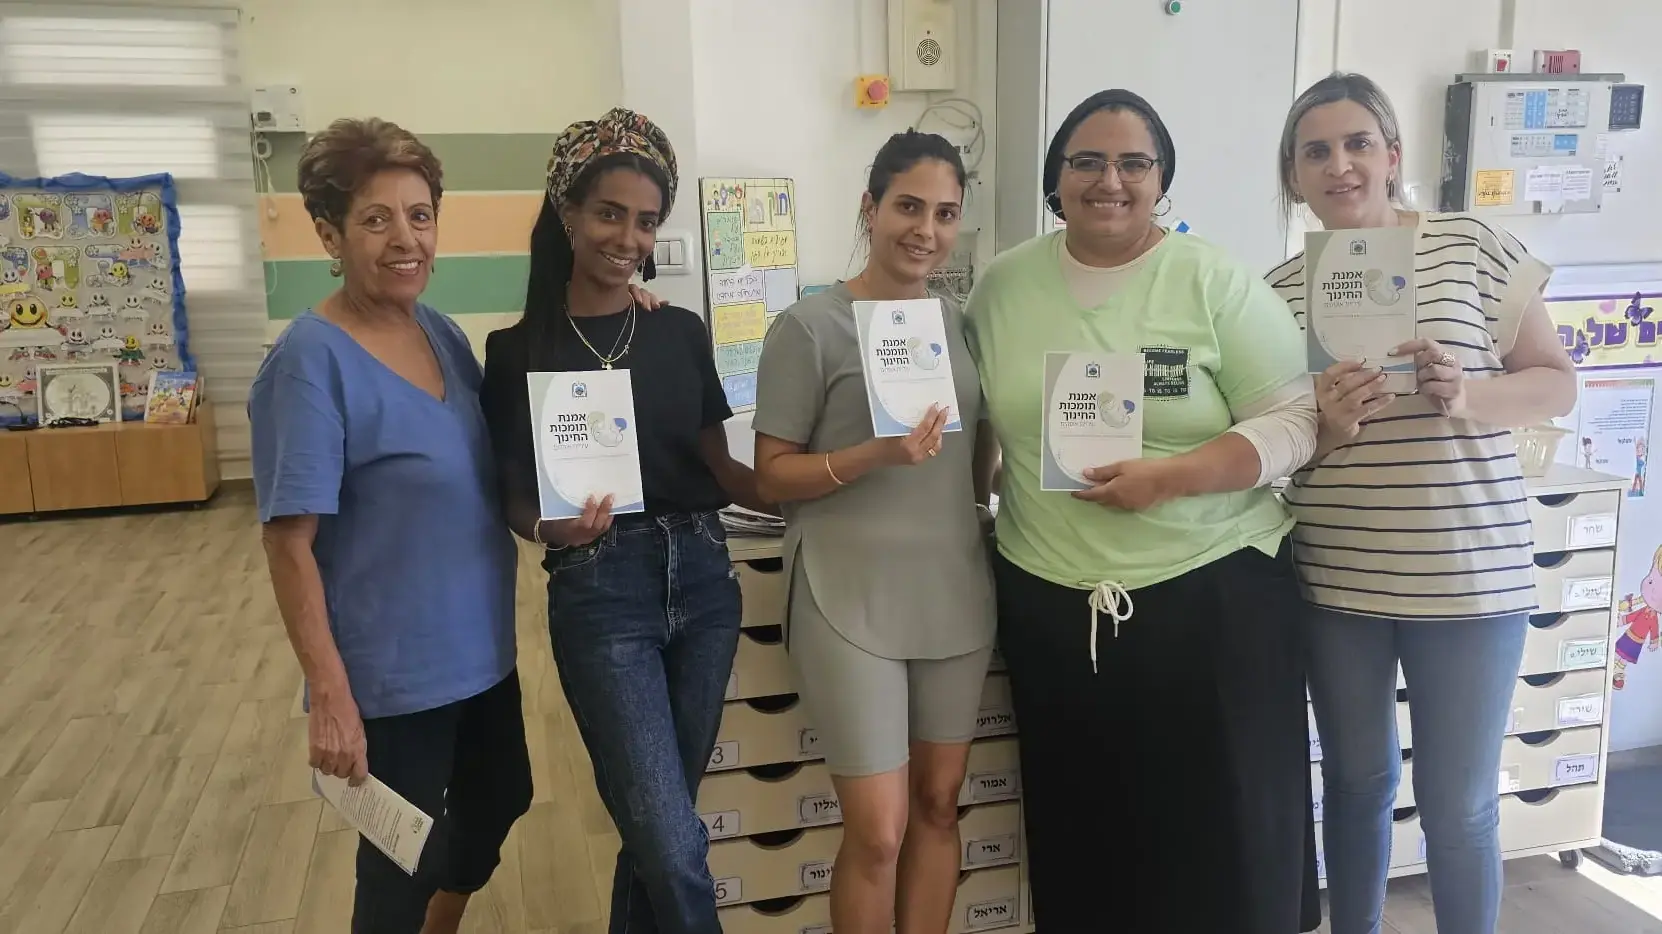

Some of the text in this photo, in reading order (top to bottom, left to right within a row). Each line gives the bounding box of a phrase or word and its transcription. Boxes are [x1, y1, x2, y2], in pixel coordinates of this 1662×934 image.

[1331, 271, 1363, 281] אמנת
[1322, 281, 1362, 290] תומכות
[1326, 291, 1362, 302] החינוך
[1586, 316, 1627, 345] של
[881, 338, 906, 348] אמנת
[876, 348, 908, 357] תומכות
[880, 357, 910, 367] החינוך
[1068, 392, 1097, 401] אמנת
[1059, 401, 1096, 410] תומכות
[557, 412, 587, 423] אמנת
[1063, 411, 1096, 421] החינוך
[549, 422, 588, 433] תומכות
[555, 432, 588, 444] החינוך
[1583, 524, 1603, 535] שחר
[710, 745, 722, 764] 3
[1566, 763, 1585, 773] תהל
[979, 776, 1006, 789] אמור
[812, 798, 837, 813] אלין
[710, 815, 723, 832] 4
[980, 843, 999, 853] ארי
[714, 883, 725, 900] 5
[973, 903, 1006, 919] אריאל
